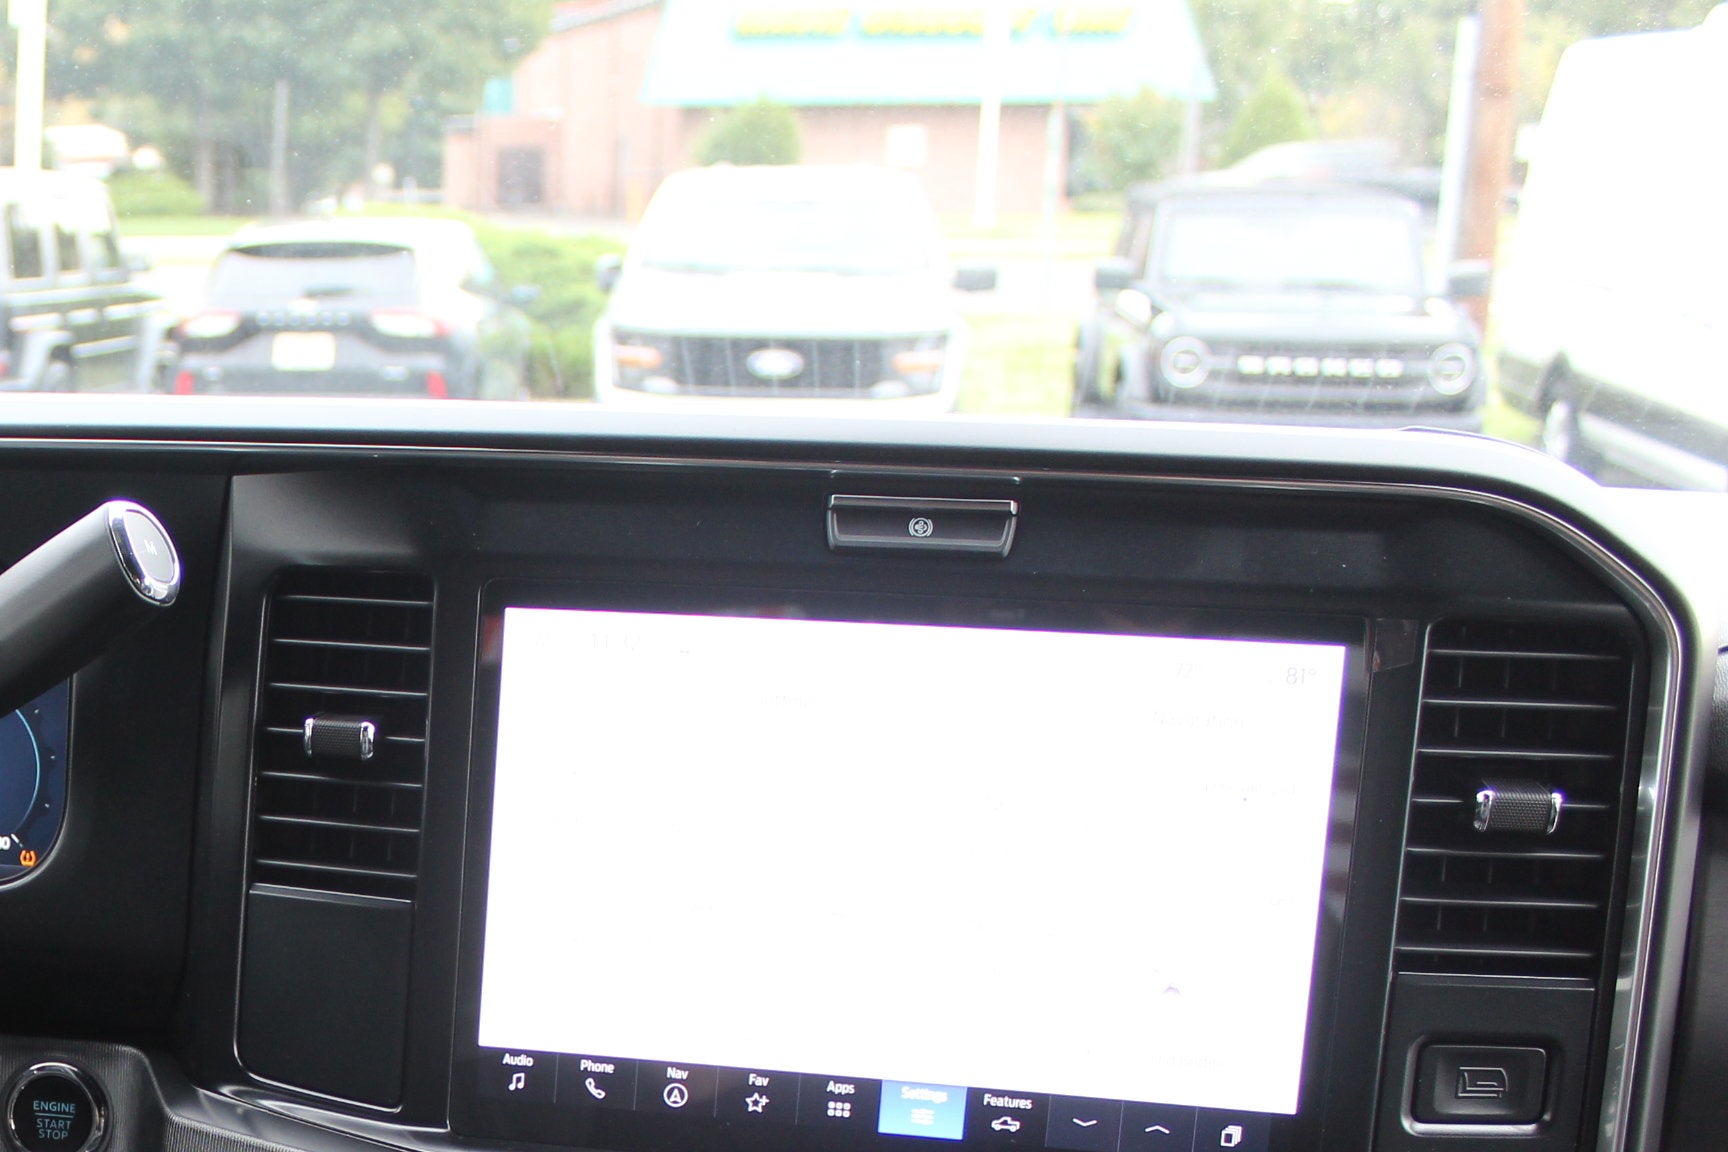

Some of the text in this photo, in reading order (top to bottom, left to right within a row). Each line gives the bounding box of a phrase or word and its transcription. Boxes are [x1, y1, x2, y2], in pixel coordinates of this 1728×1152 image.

[503, 1053, 534, 1067] Audio
[580, 1059, 615, 1074] Phone
[667, 1067, 689, 1080] Nav
[748, 1073, 770, 1087] Fav
[826, 1080, 855, 1096] Apps
[33, 1100, 76, 1114] ENGINE
[983, 1093, 1033, 1110] Features
[36, 1118, 72, 1130] START
[38, 1129, 69, 1140] STOP
